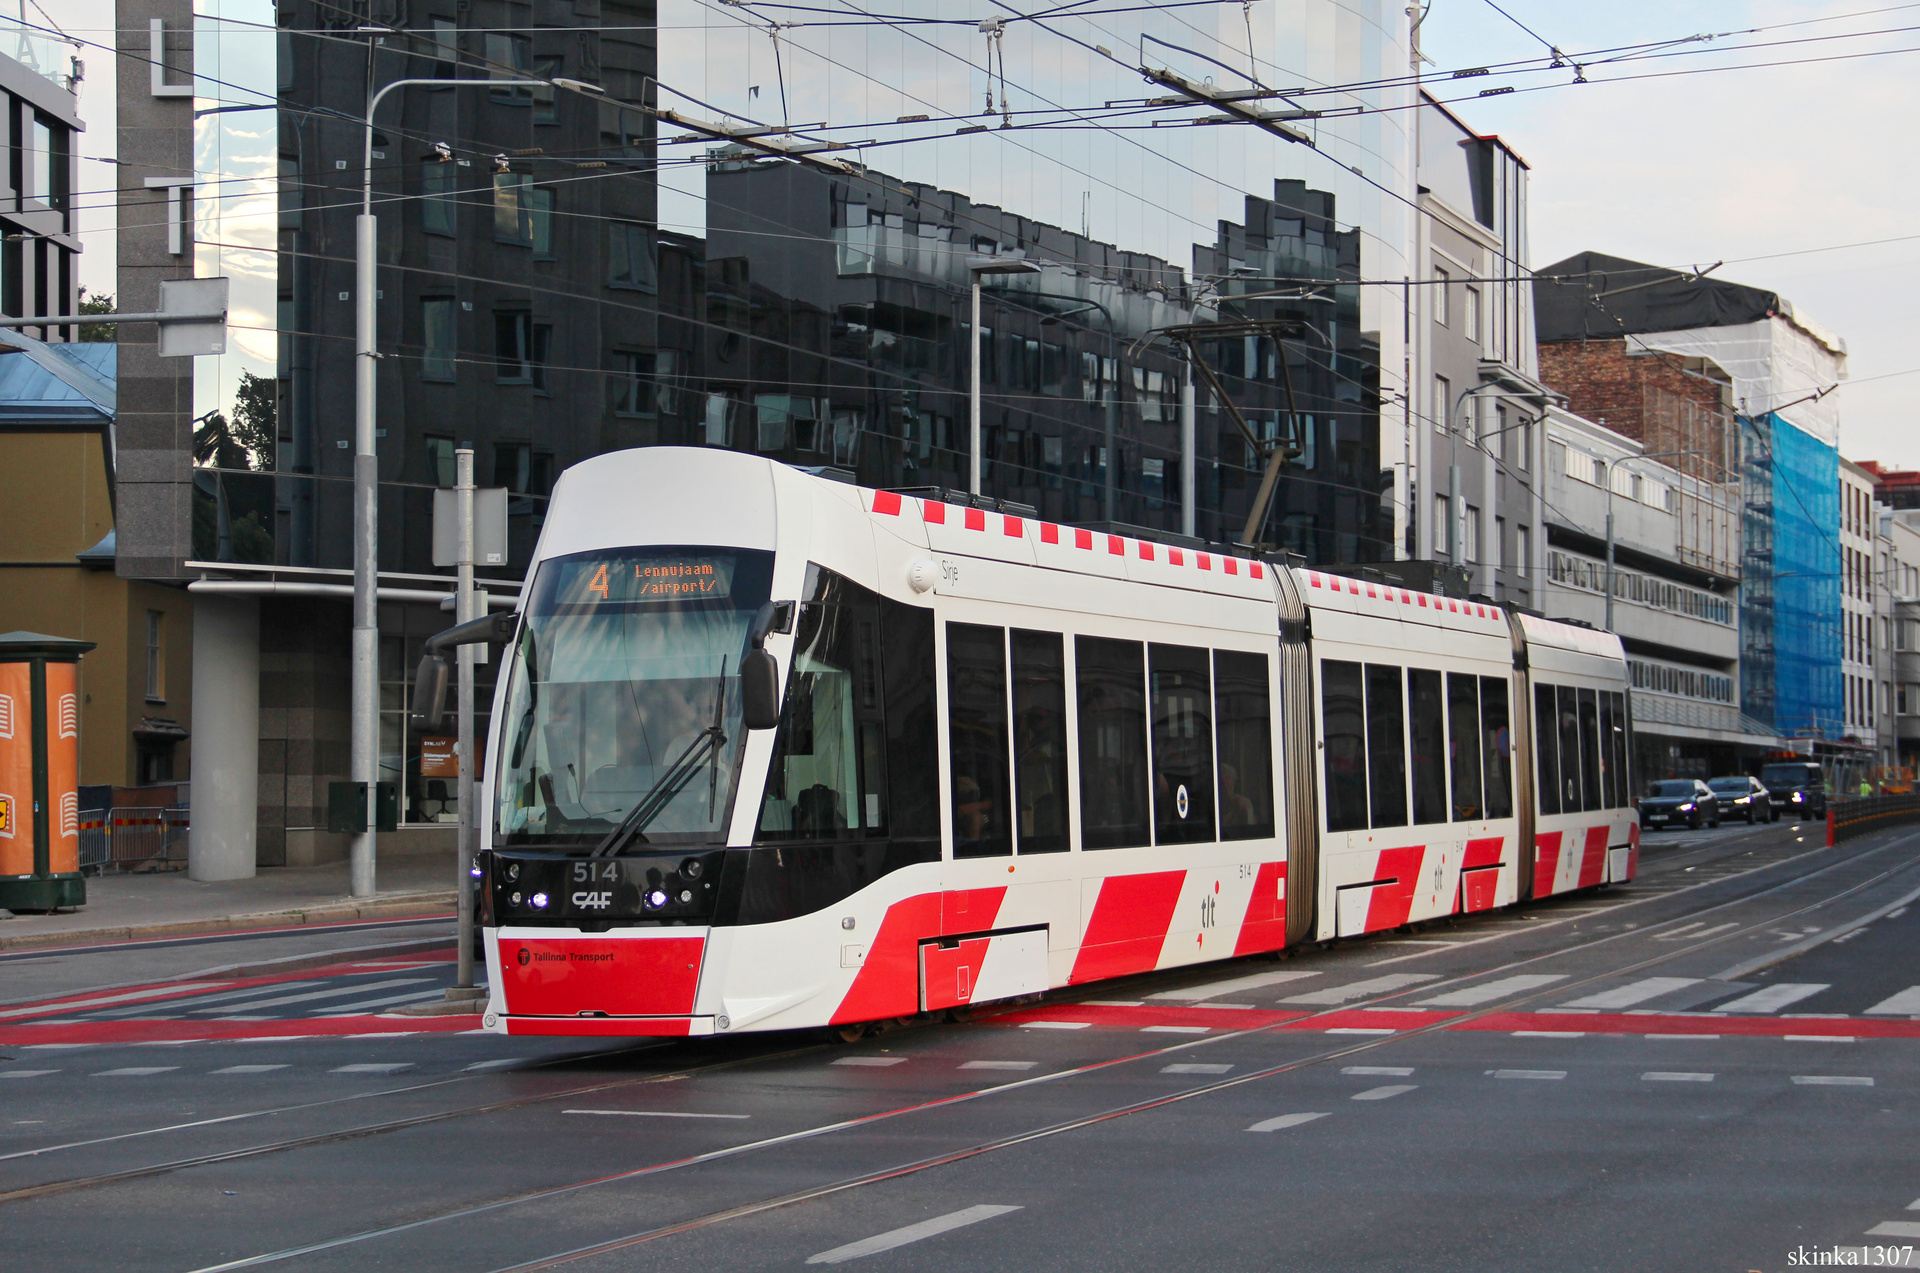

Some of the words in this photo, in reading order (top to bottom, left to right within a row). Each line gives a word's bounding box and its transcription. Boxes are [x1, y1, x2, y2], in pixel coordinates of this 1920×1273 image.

[635, 562, 714, 577] Lennujaam
[942, 559, 958, 587] Sirje
[589, 563, 609, 599] 4
[640, 578, 716, 594] /airport/
[573, 861, 618, 882] 514
[1239, 864, 1251, 879] 514
[571, 891, 612, 909] CAF
[533, 952, 567, 961] Tallinna
[569, 952, 615, 963] Transport
